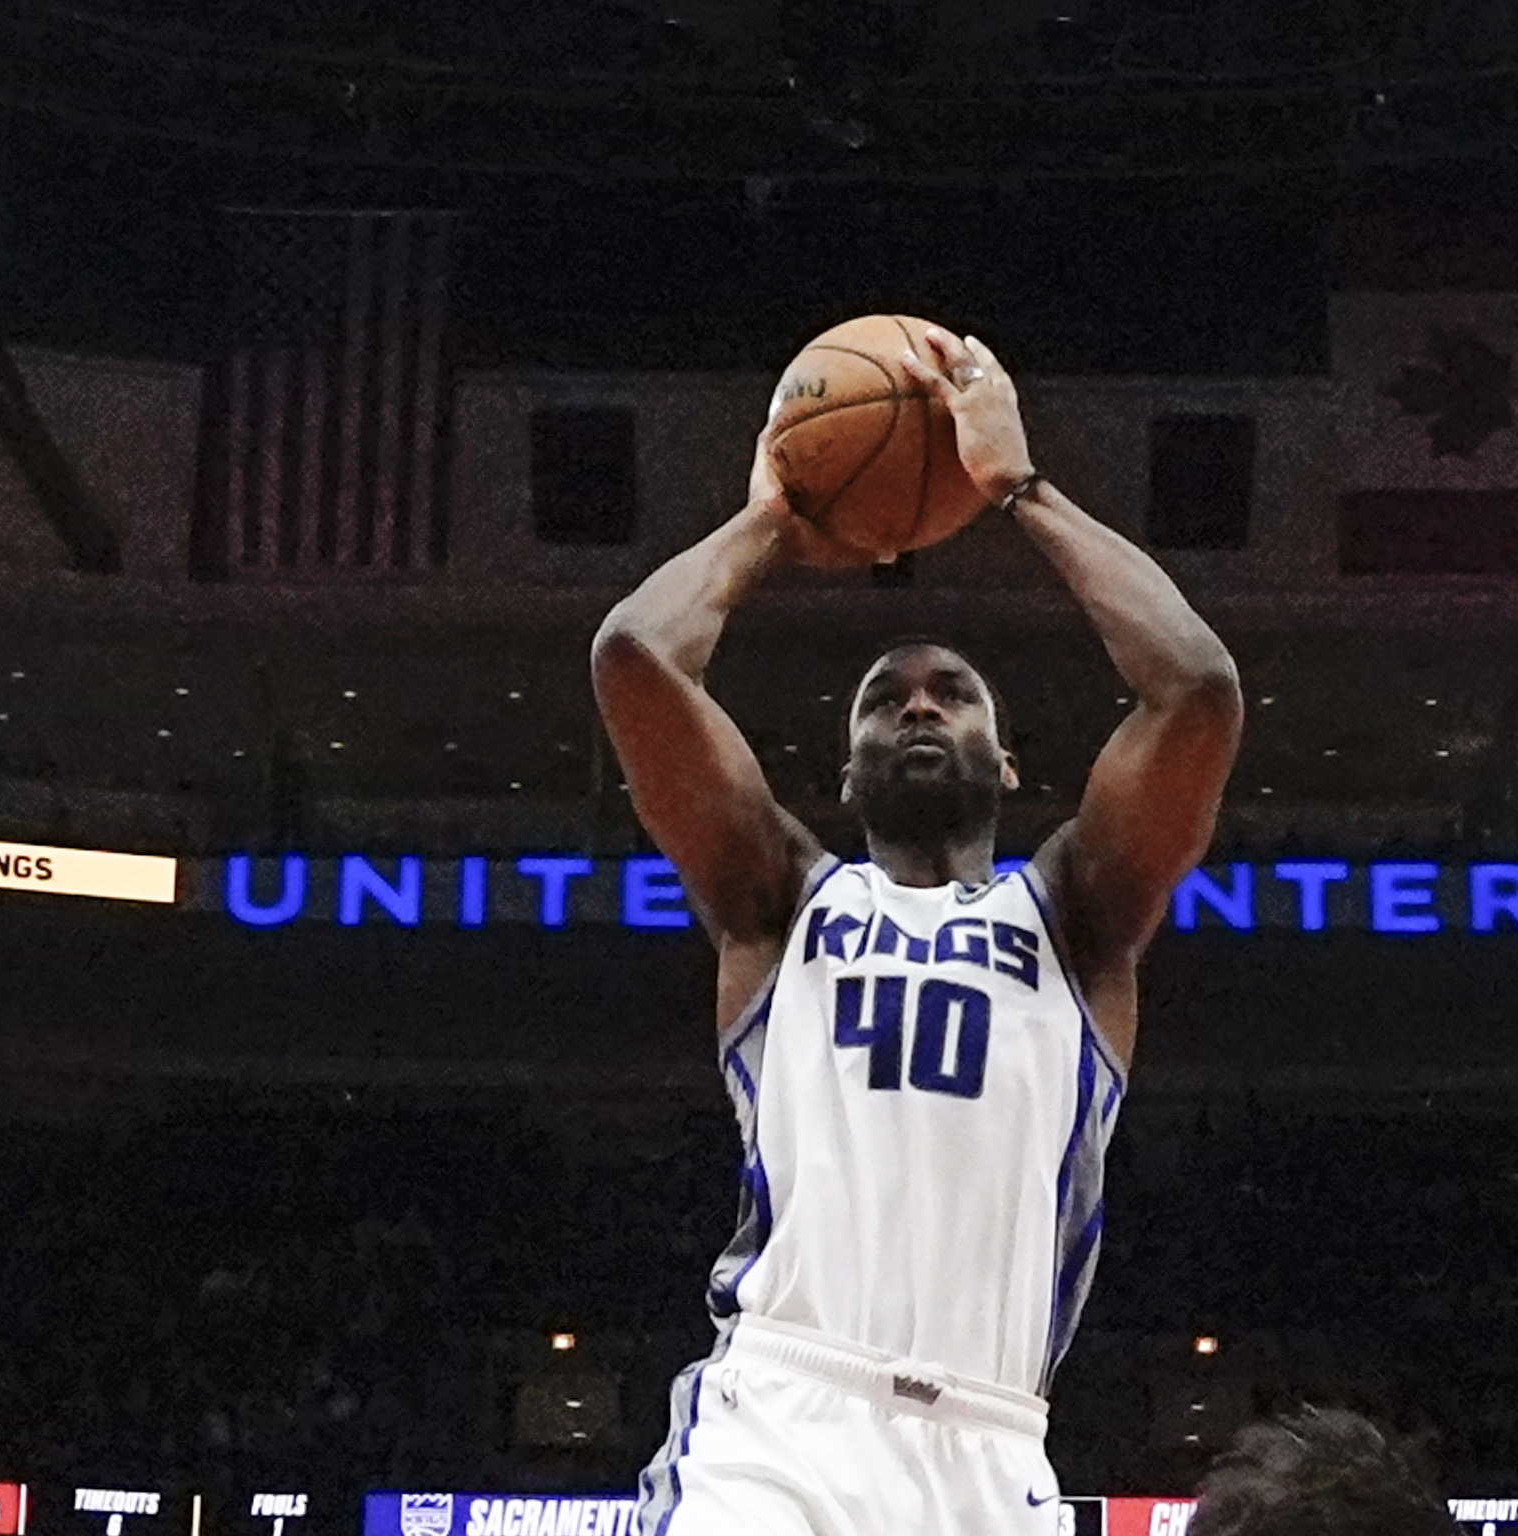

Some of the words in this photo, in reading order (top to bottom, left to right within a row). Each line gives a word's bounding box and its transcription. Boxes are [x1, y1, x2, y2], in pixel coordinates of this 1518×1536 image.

[226, 852, 693, 928] UNITE
[802, 906, 1040, 992] KINGS
[833, 975, 992, 1101] 40
[74, 1488, 161, 1515] TIMEOUTS
[251, 1493, 309, 1517] FOULS
